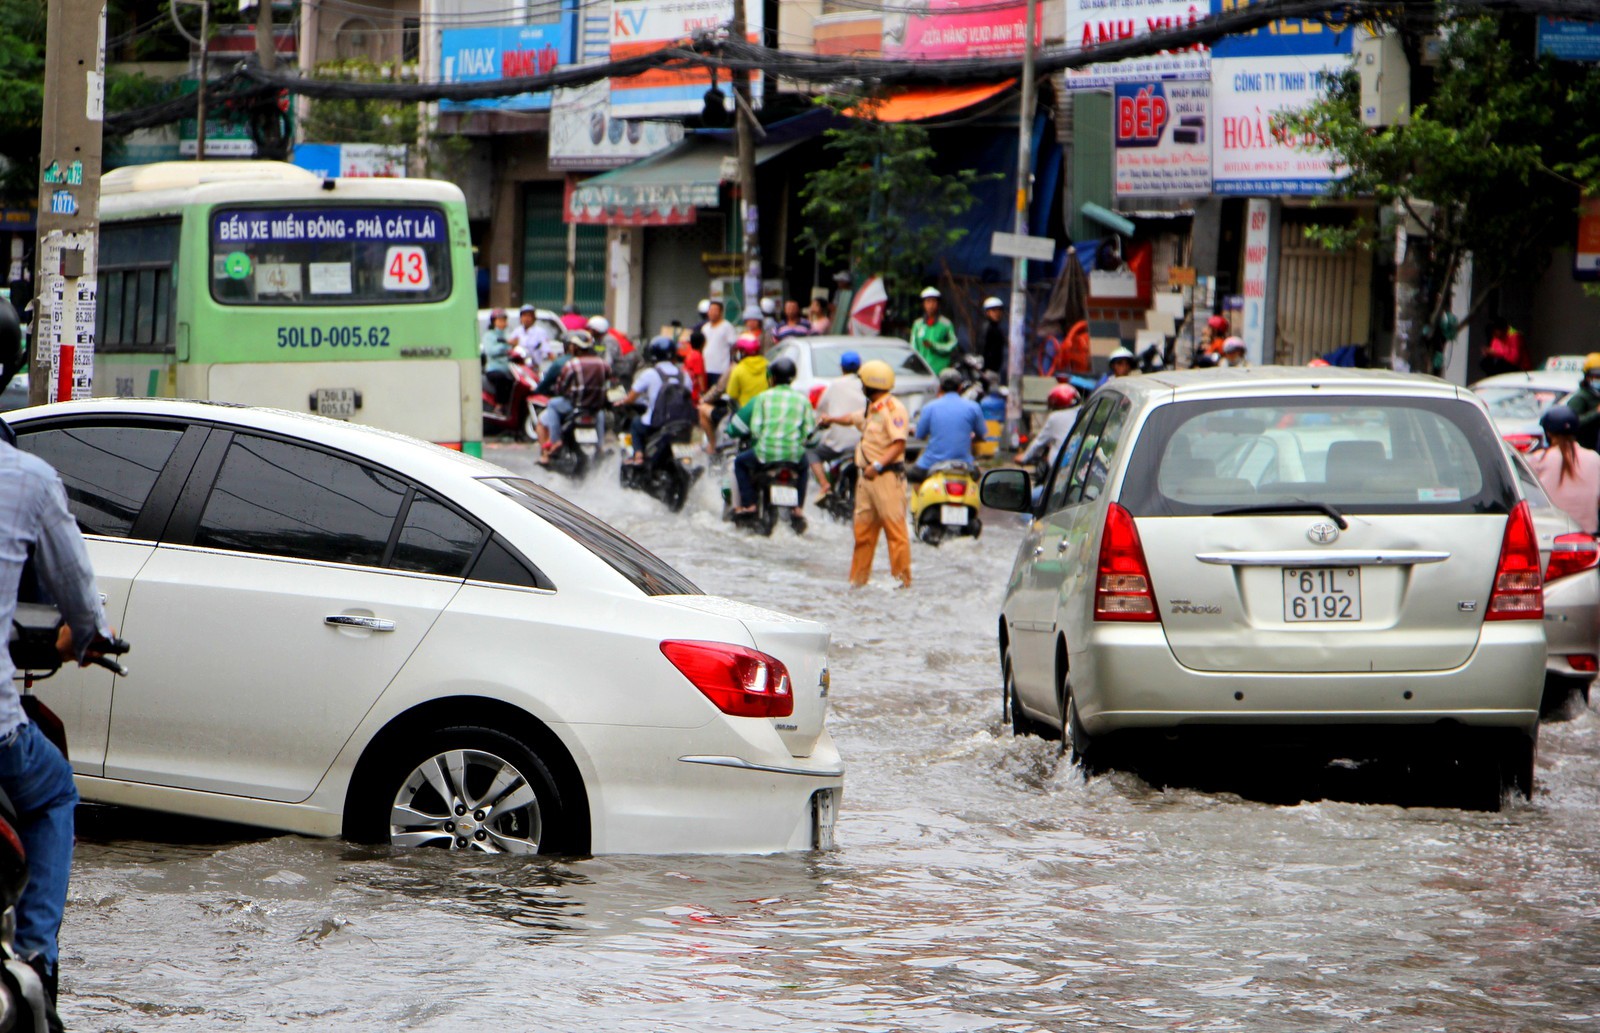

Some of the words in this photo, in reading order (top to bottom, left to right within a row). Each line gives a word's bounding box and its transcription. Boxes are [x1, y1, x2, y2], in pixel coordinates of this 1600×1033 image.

[943, 24, 968, 44] HÀNG
[993, 24, 1013, 41] ANH
[1082, 18, 1135, 50] ANH
[459, 48, 495, 75] INAX
[1234, 68, 1261, 91] CÔNG
[1265, 72, 1276, 90] TY
[1279, 71, 1306, 91] TNHH
[1119, 84, 1168, 139] BẾP
[220, 214, 248, 240] BẾN
[251, 220, 269, 239] XE
[307, 215, 346, 239] ĐÔNG
[356, 216, 384, 238] PHÀ
[386, 215, 412, 238] CÁT
[414, 215, 436, 238] LÁI
[389, 252, 424, 285] 43
[277, 326, 391, 348] 50LD-005.62
[1300, 570, 1344, 593] 61L
[1293, 595, 1353, 618] 6192
